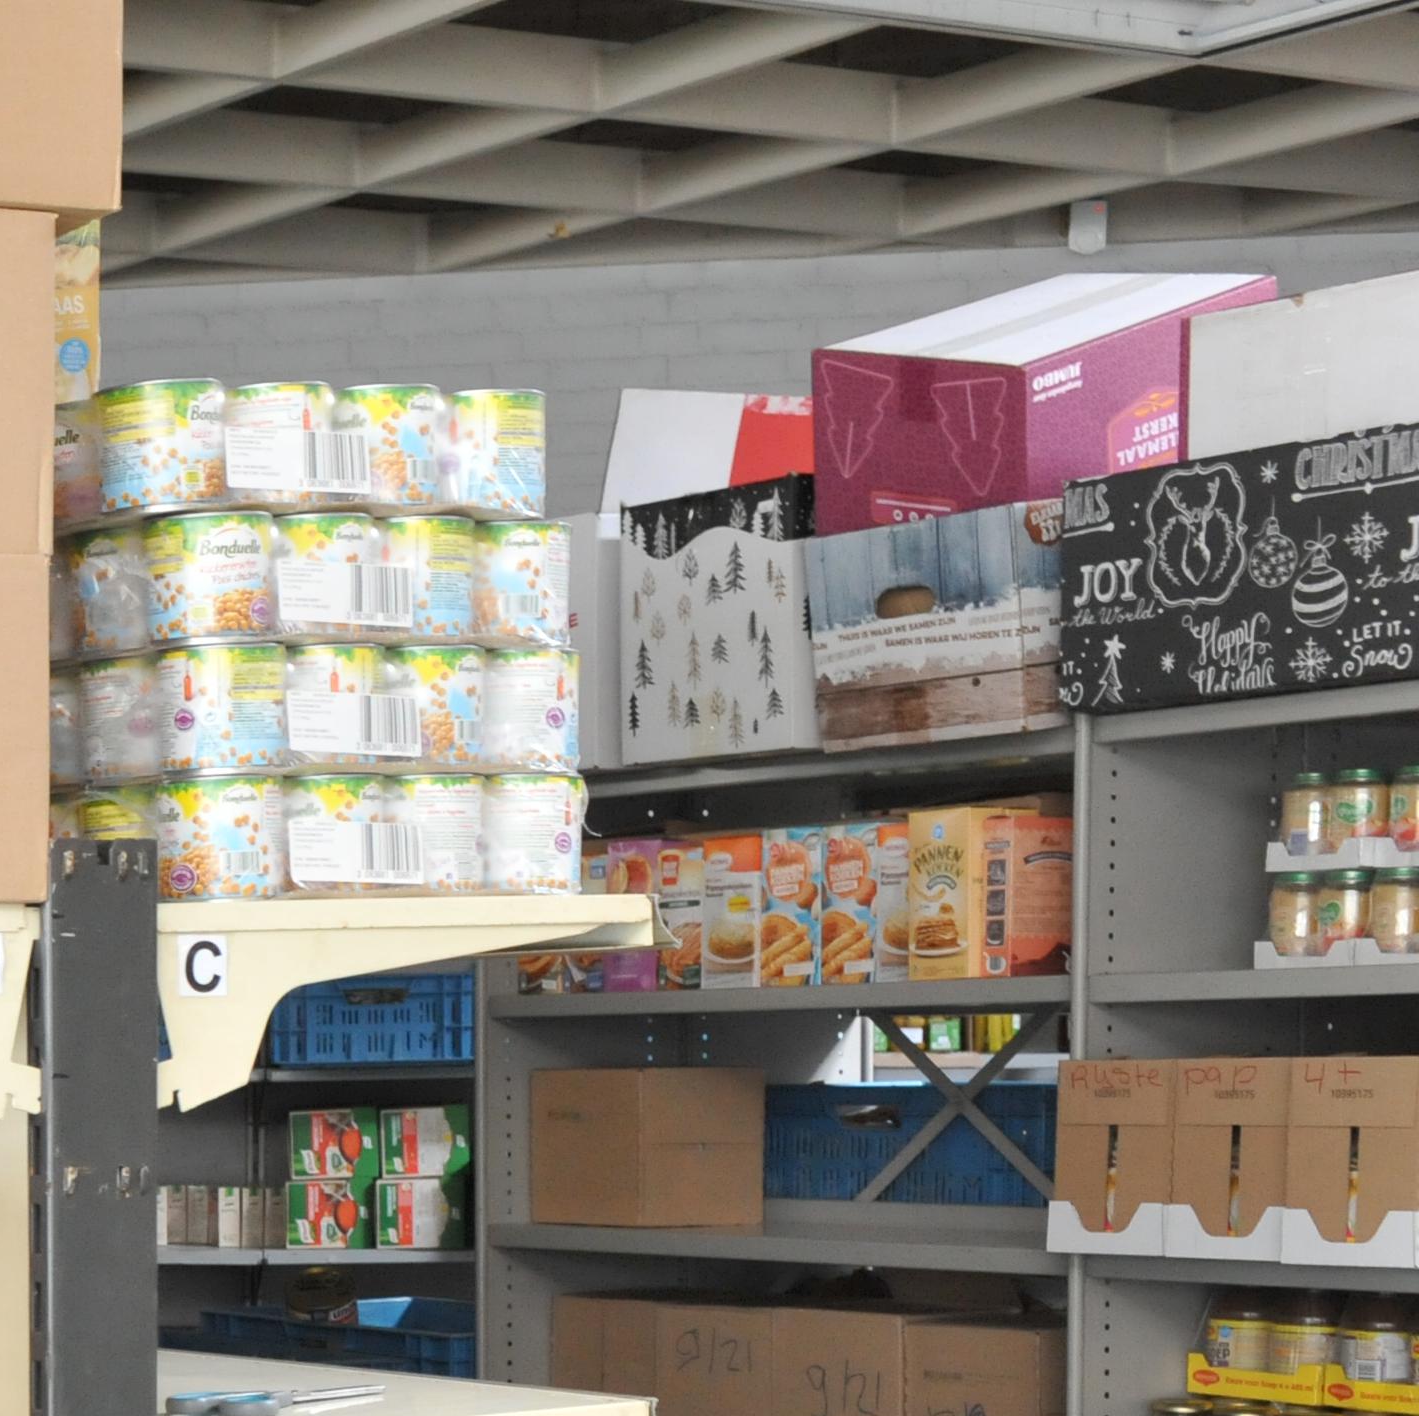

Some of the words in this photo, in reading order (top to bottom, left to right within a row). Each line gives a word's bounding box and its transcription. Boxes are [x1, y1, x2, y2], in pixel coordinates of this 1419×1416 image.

[1032, 361, 1083, 392] JUMBO
[1131, 412, 1179, 443] KERST
[200, 538, 261, 558] Bonduelle
[1074, 558, 1143, 607] JOY
[909, 620, 936, 633] SAMEN
[1100, 599, 1157, 625] World
[885, 637, 913, 648] SAMEN
[1182, 612, 1273, 667] Happy
[1351, 622, 1383, 643] LET
[1341, 643, 1414, 679] Snow
[913, 844, 964, 874] PANNEN
[185, 941, 222, 993] C
[1185, 1064, 1258, 1097] pap
